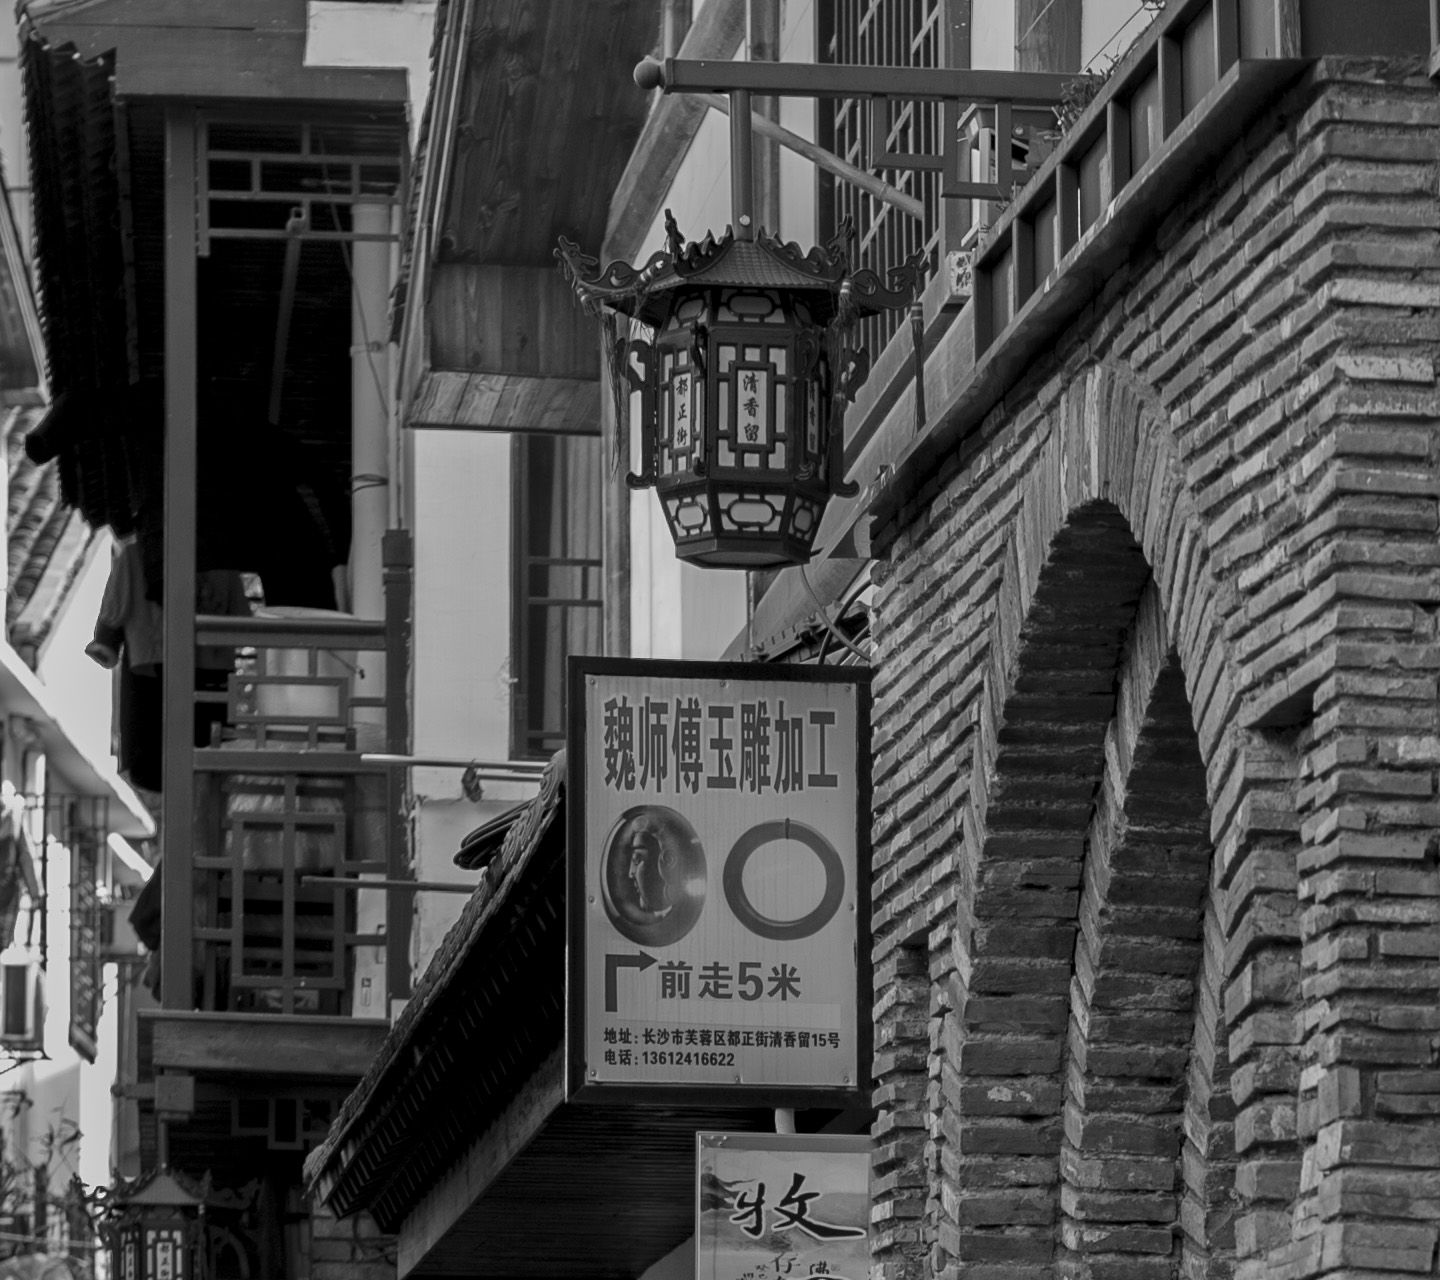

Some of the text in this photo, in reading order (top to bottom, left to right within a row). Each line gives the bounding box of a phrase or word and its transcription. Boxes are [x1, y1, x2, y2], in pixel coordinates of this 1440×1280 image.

[675, 376, 689, 446] 都正街
[742, 372, 760, 443] 清香留
[603, 695, 839, 794] 魏师傅玉雕加工
[658, 960, 801, 1001] 前走5米
